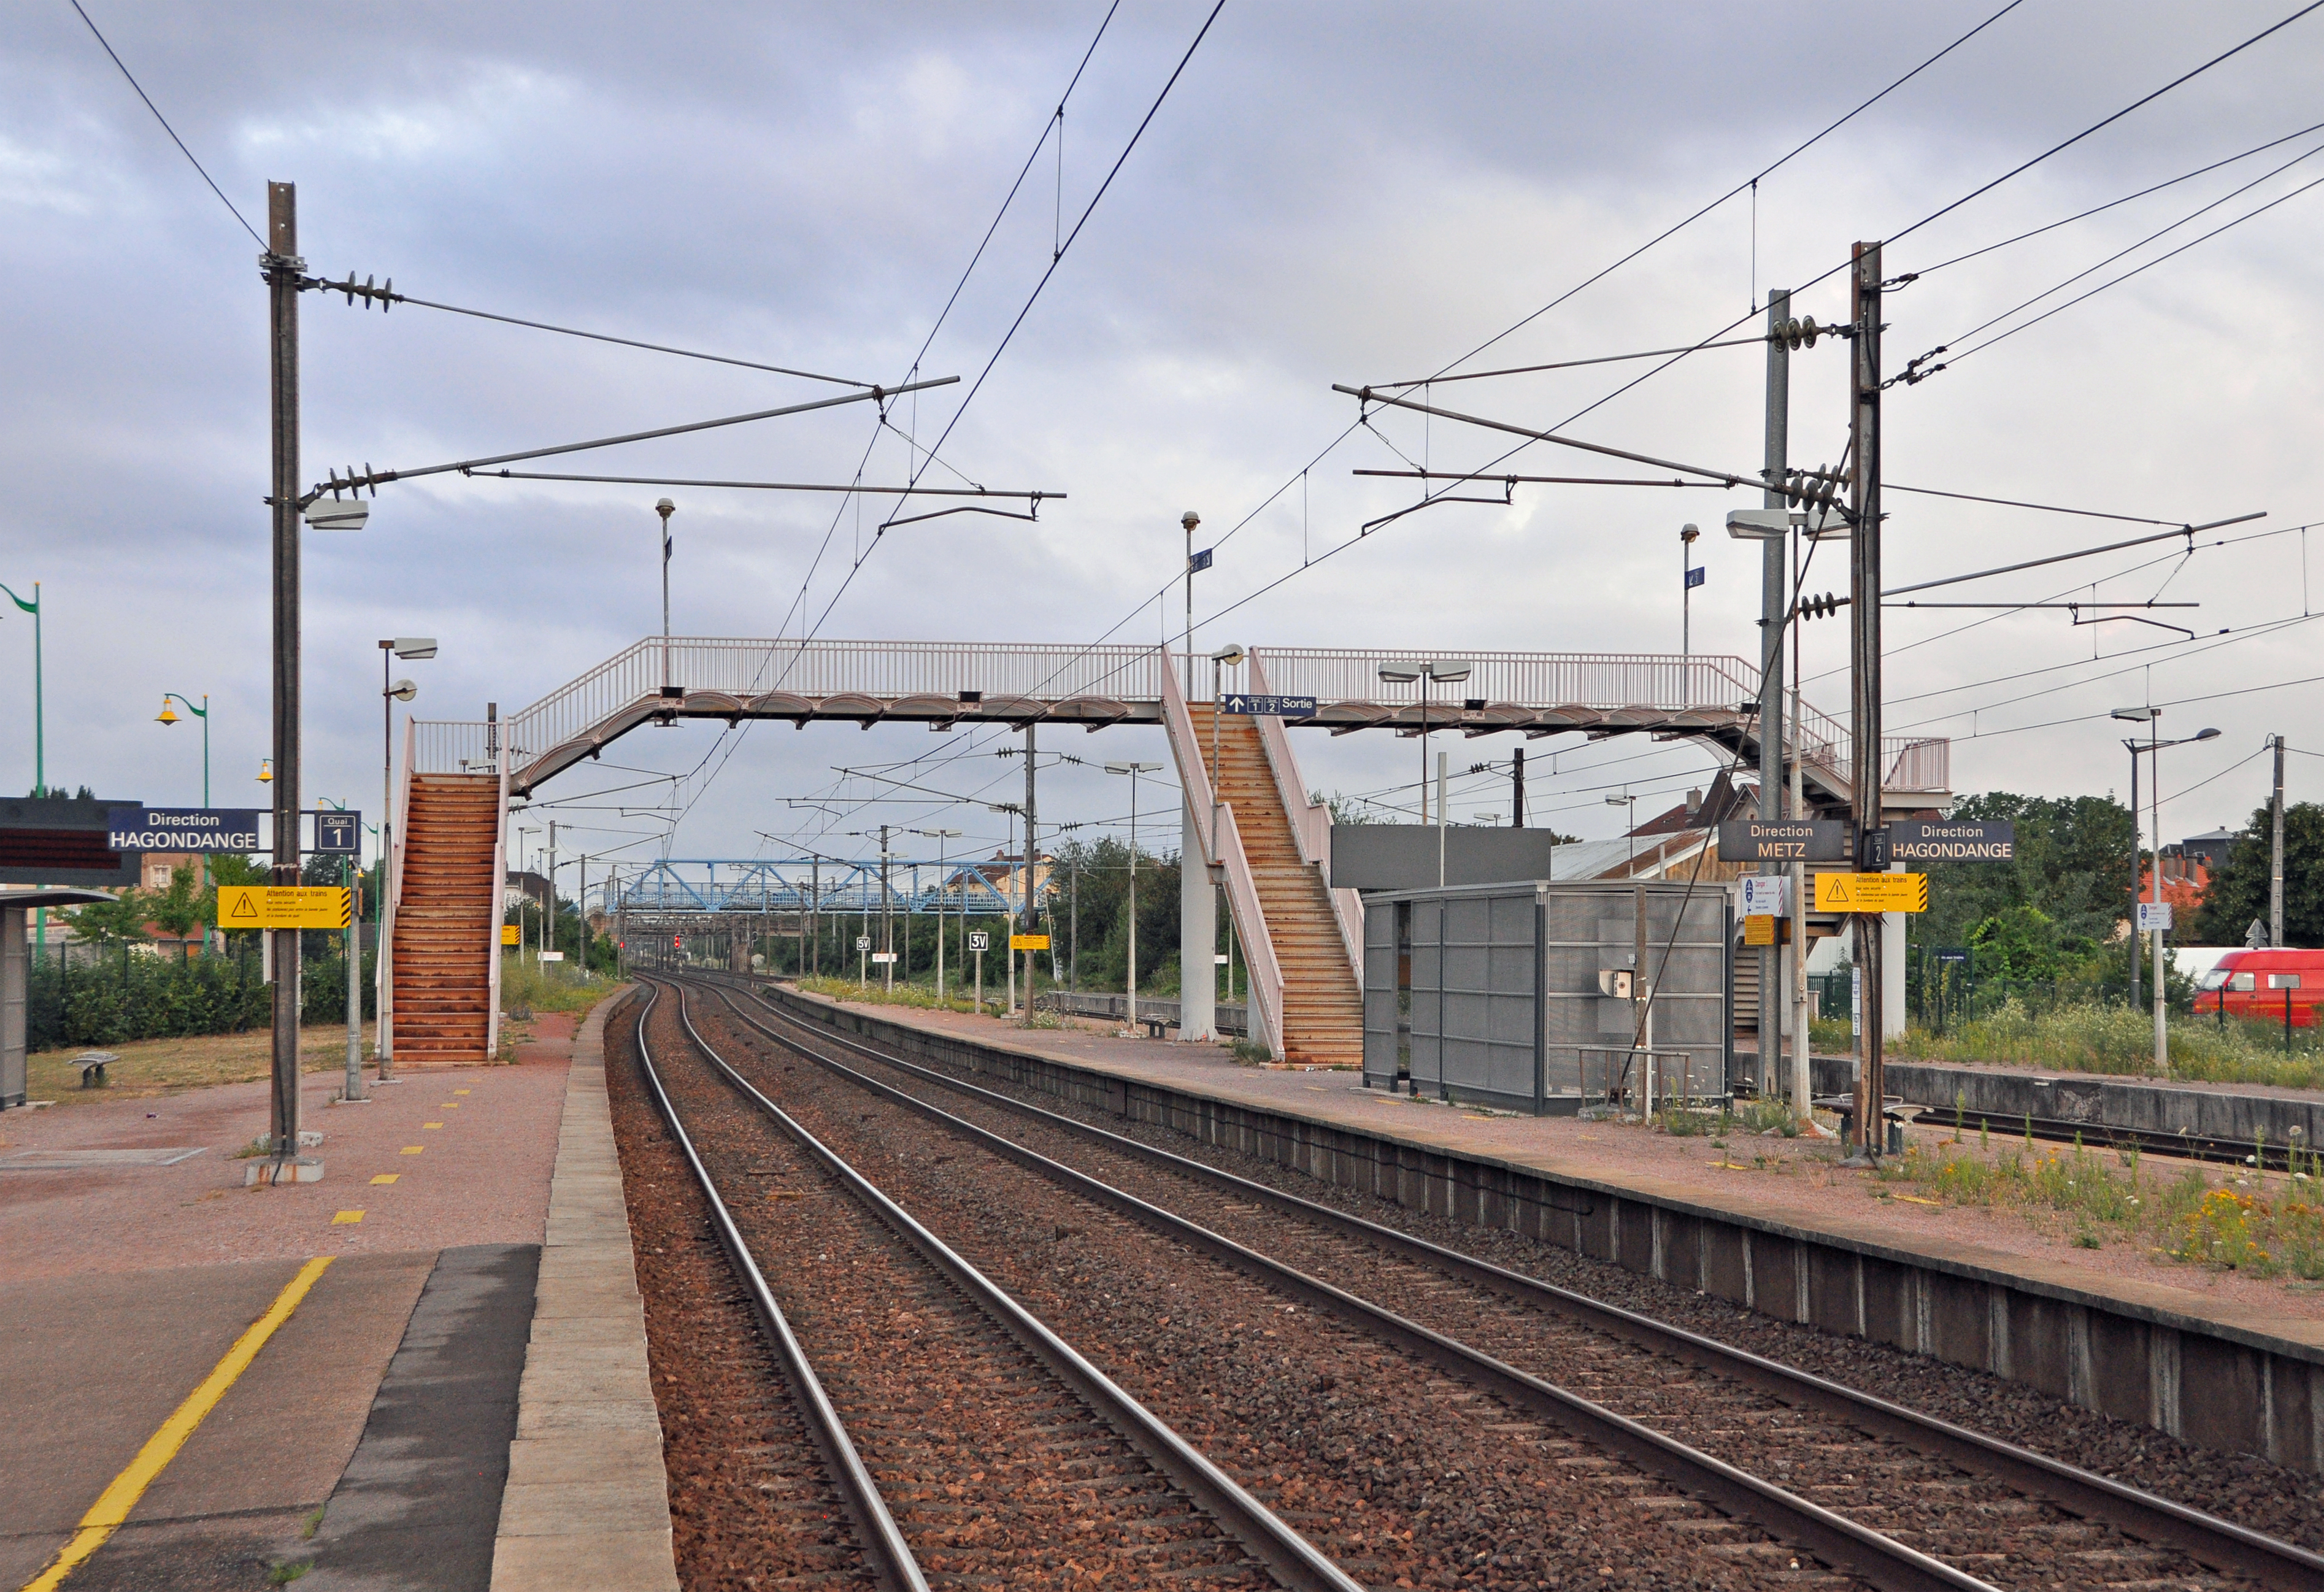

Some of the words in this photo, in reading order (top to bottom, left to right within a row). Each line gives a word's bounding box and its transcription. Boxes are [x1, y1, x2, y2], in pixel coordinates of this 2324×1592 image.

[1269, 703, 1275, 712] 2
[1282, 698, 1312, 709] Sortie
[149, 812, 219, 826] Direction
[333, 828, 341, 846] 1
[1751, 825, 1813, 837] Direction
[1922, 825, 1983, 837] Direction
[110, 831, 256, 848] HAGONDANGE
[1758, 842, 1806, 857] METZ
[1876, 845, 1881, 862] 2
[1893, 843, 2012, 858] HAGONDANGE
[858, 939, 868, 948] 5V
[972, 935, 986, 948] 3V
